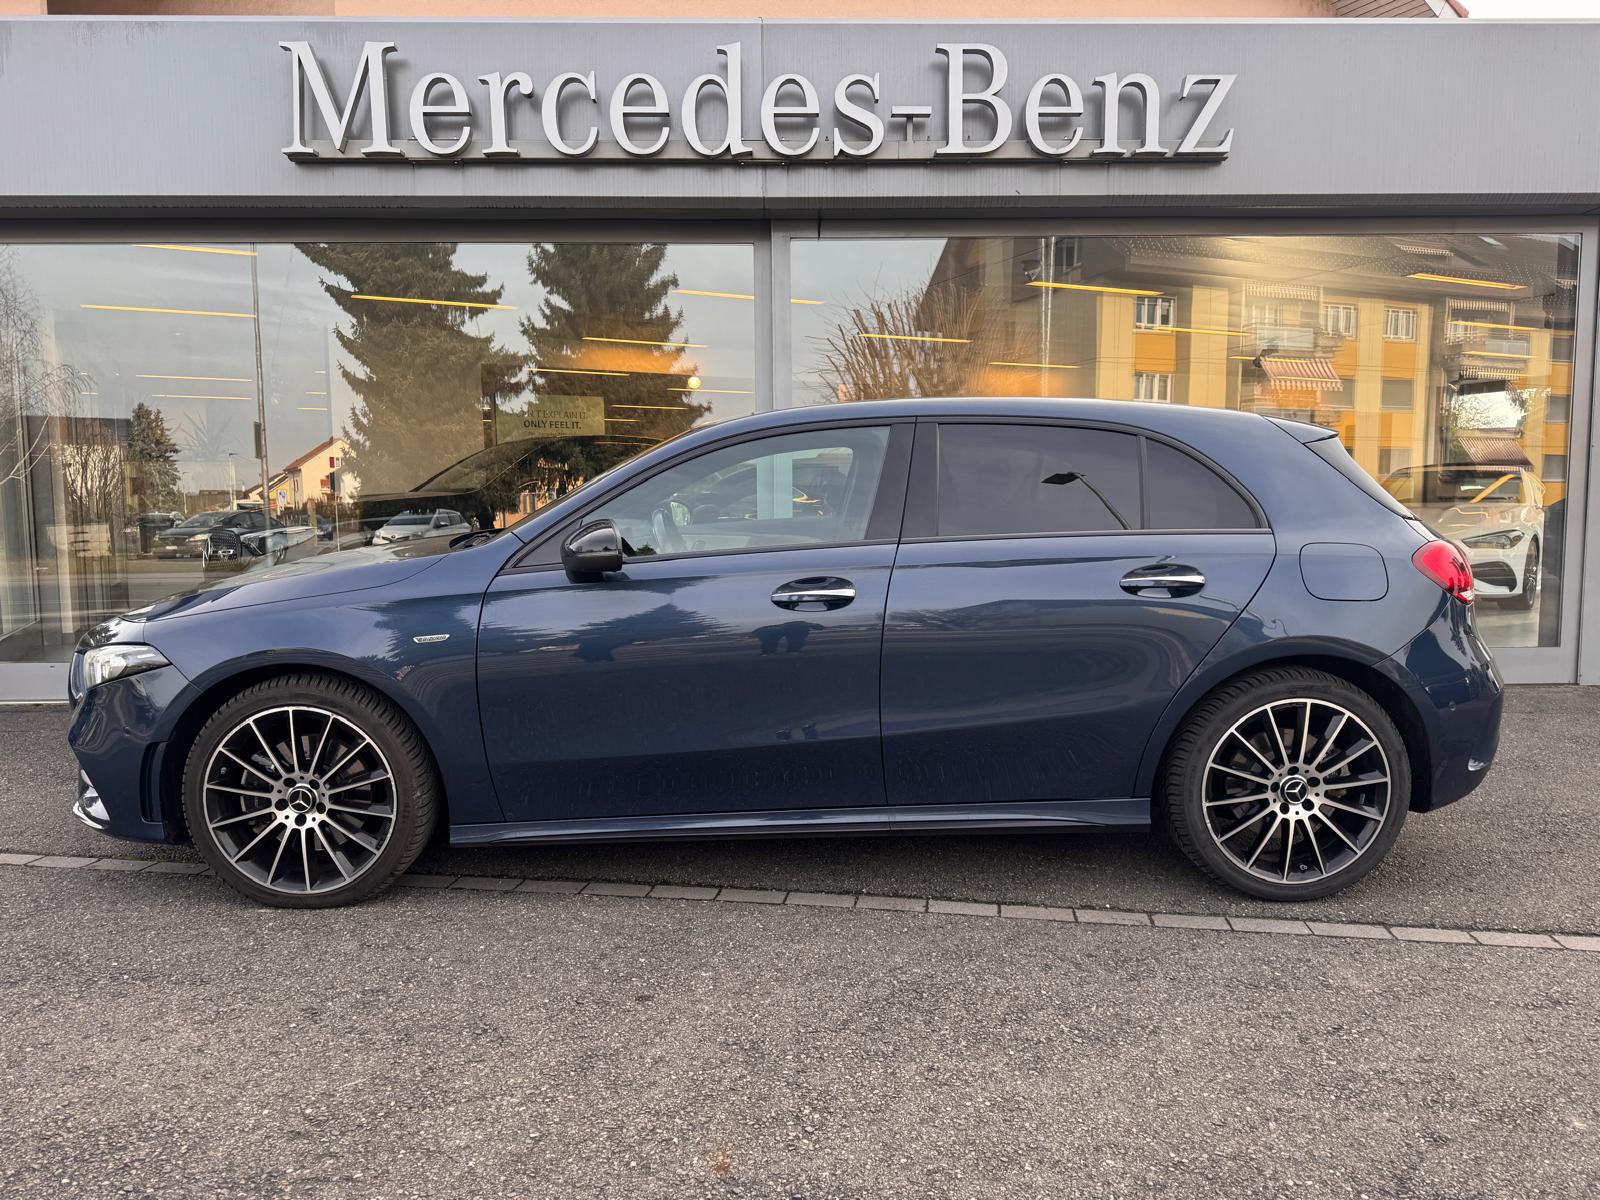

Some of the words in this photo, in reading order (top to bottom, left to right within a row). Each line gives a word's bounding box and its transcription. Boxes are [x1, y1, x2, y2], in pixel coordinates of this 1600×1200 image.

[278, 41, 1237, 158] Mercedes-Benz
[543, 410, 577, 419] EXPLAIN
[523, 420, 547, 429] ONLY
[549, 420, 570, 429] FEEL
[571, 421, 582, 430] IT.
